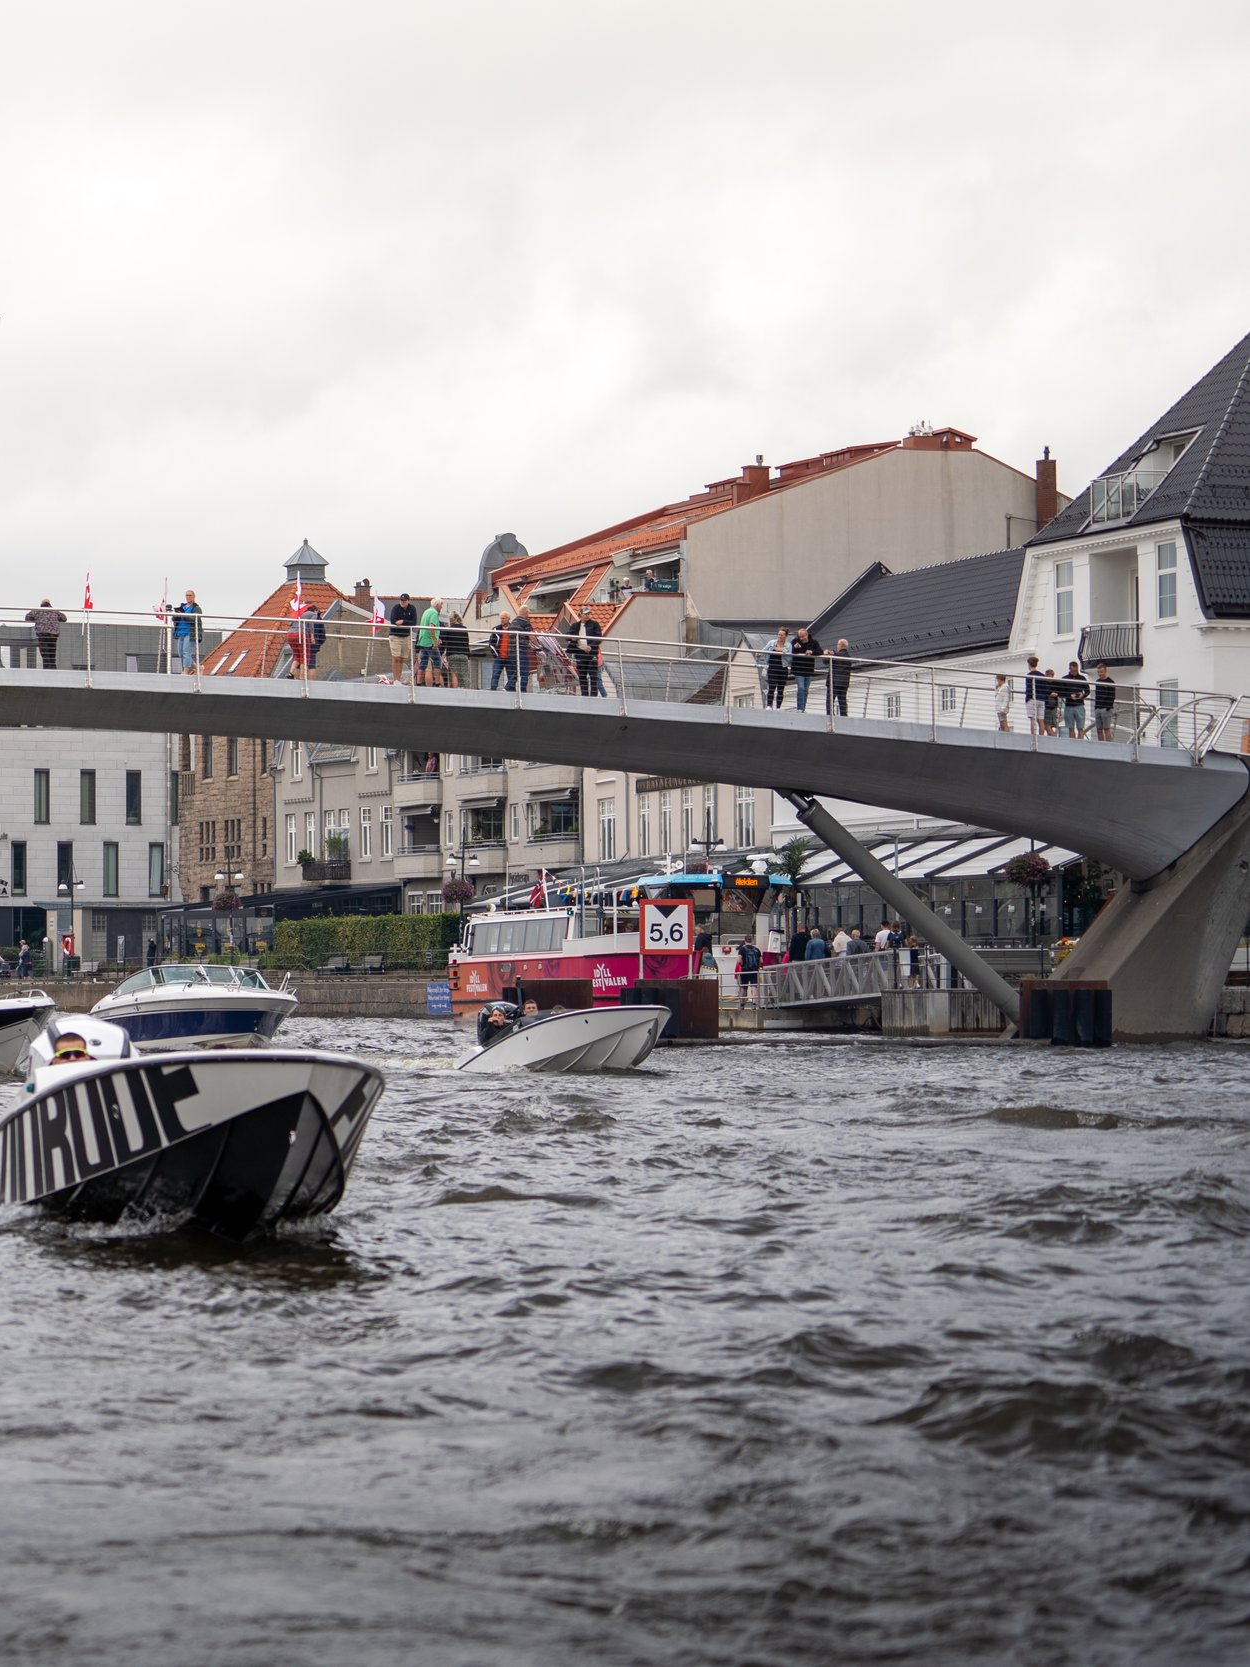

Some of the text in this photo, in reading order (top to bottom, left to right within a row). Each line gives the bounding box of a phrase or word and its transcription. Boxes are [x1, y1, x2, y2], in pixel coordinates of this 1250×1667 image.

[649, 922, 684, 946] 5,6
[593, 963, 611, 978] IDYLL
[592, 976, 628, 988] ESTIVALEN
